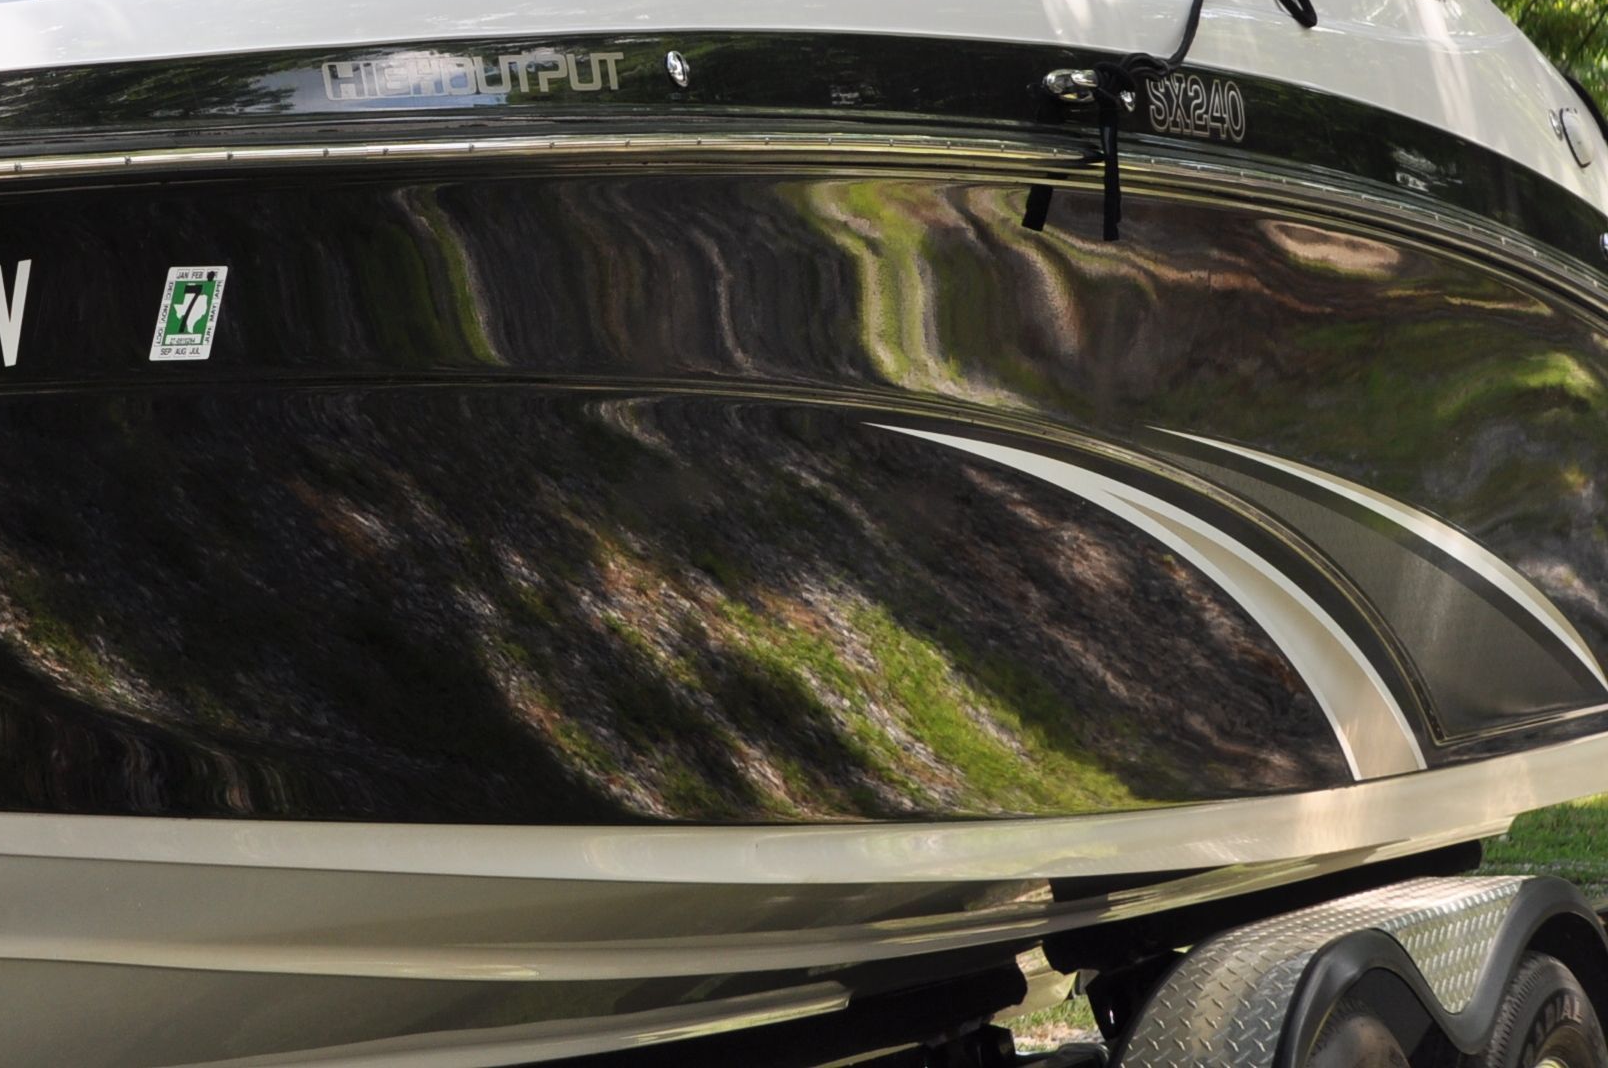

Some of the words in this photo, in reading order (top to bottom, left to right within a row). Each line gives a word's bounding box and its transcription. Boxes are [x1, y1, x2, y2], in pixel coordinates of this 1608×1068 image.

[1145, 72, 1246, 143] SX240
[176, 271, 189, 279] JAN
[191, 271, 204, 279] FEB
[179, 285, 204, 333] 7
[160, 347, 172, 355] SEP
